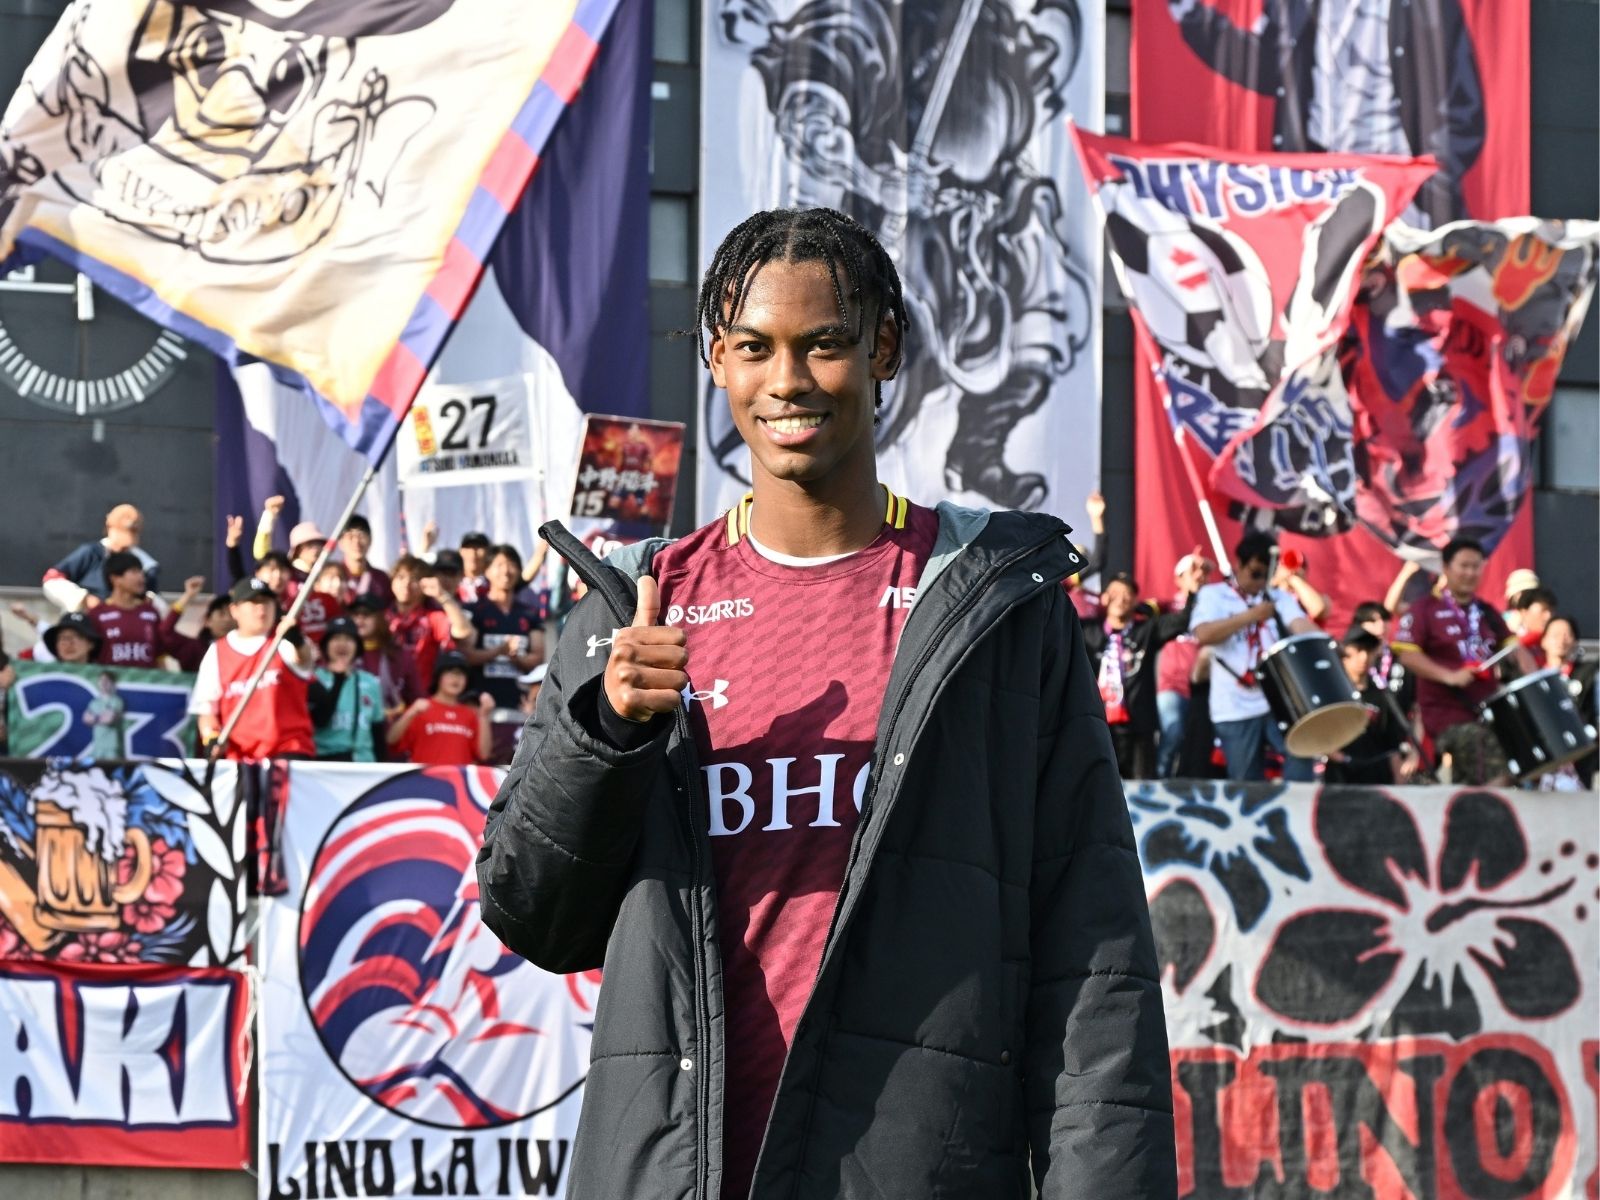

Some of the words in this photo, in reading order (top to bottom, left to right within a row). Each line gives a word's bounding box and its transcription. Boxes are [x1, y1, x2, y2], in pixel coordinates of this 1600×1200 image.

[440, 395, 496, 450] 27
[575, 490, 606, 515] 15
[685, 597, 754, 624] STARTS
[16, 672, 192, 760] 23
[0, 974, 238, 1131] AKI
[267, 1139, 395, 1200] LINO
[412, 1137, 480, 1196] LA
